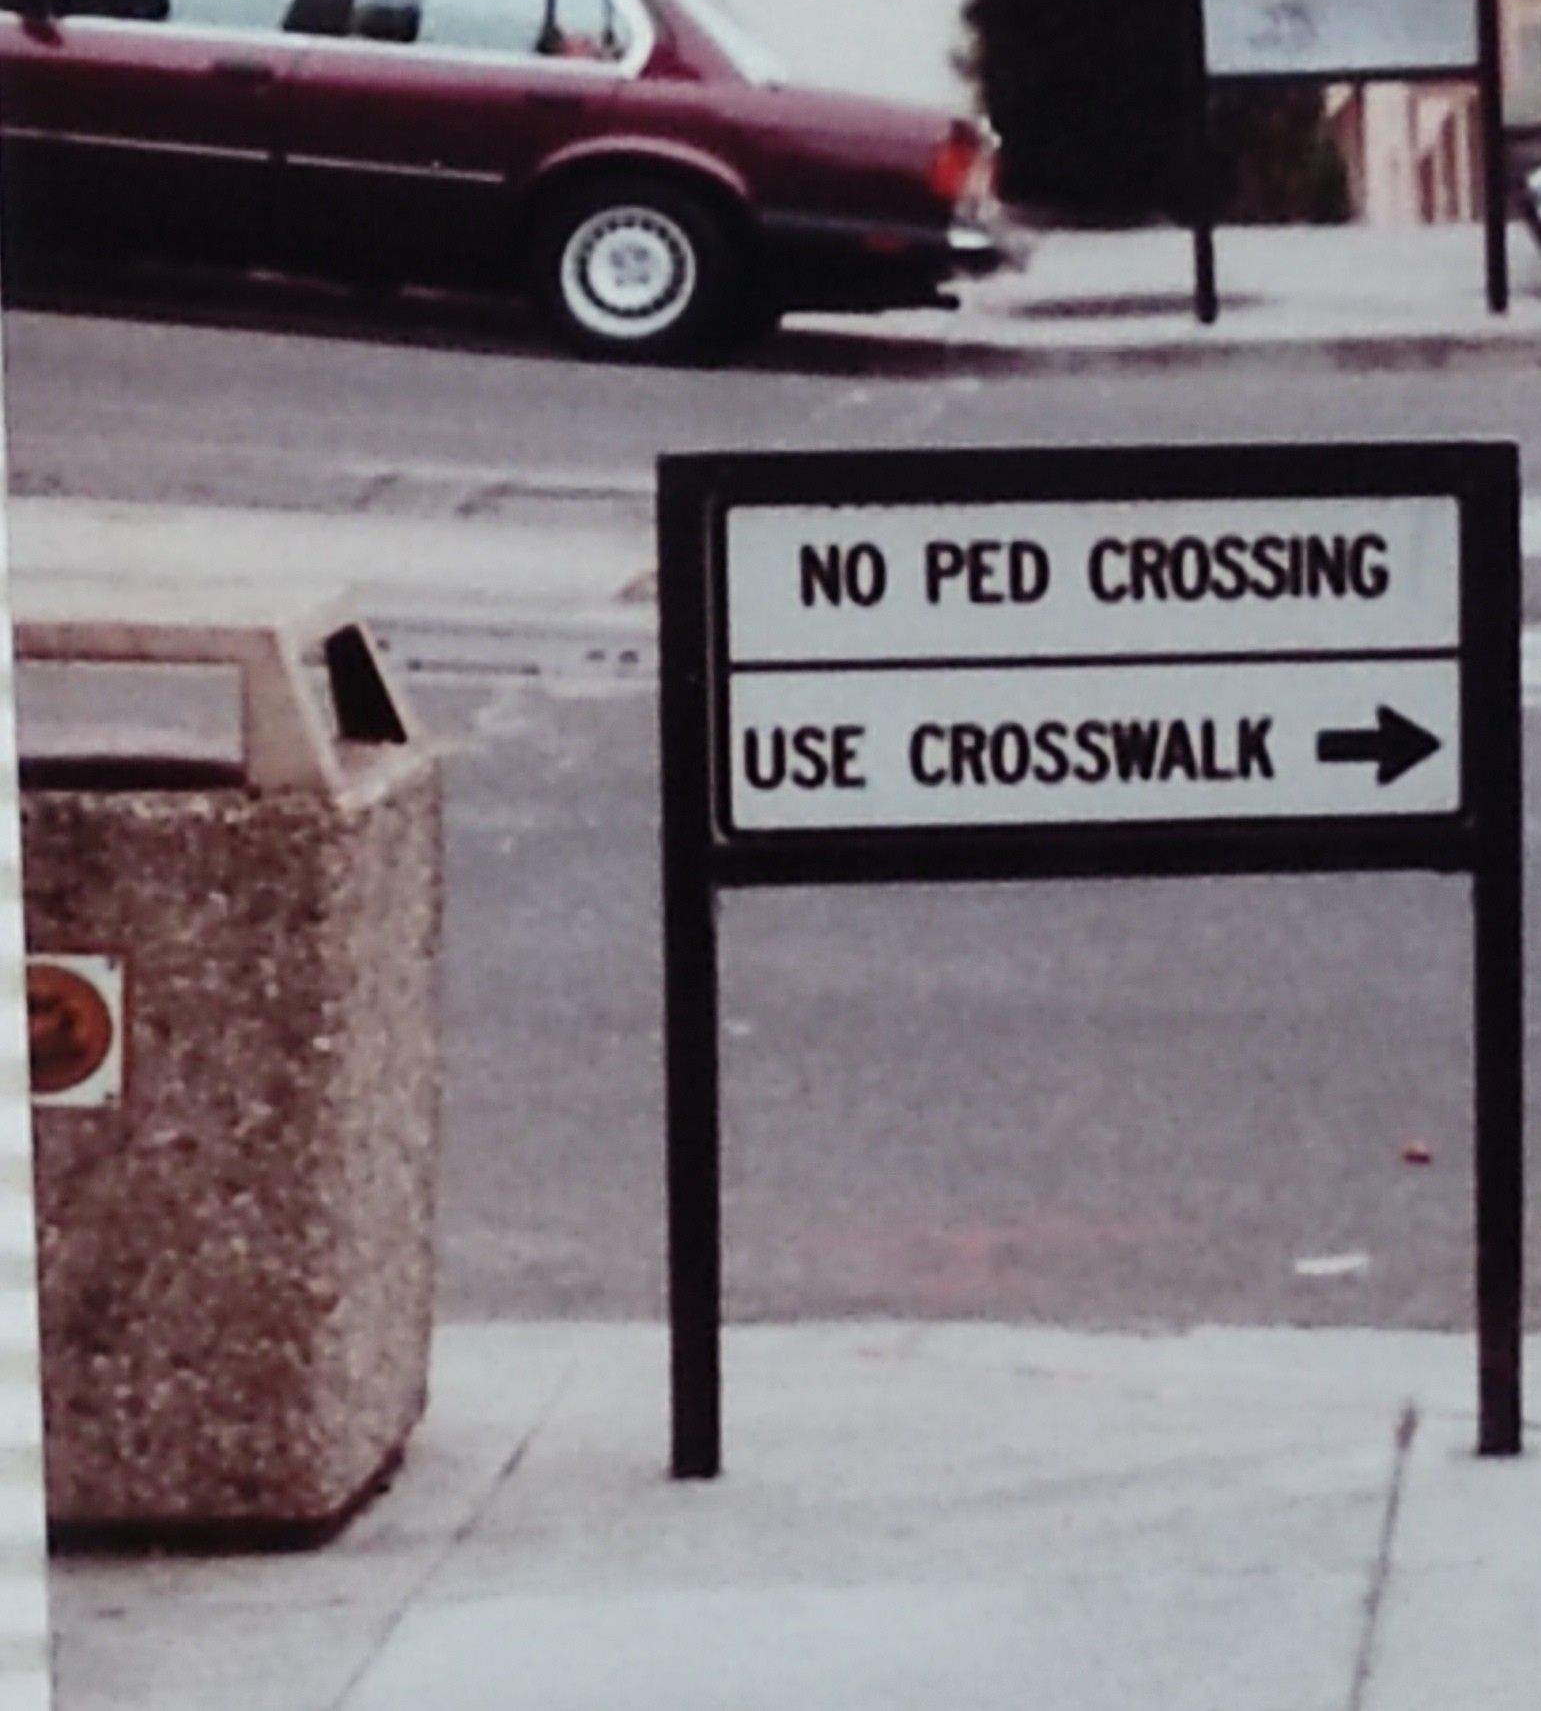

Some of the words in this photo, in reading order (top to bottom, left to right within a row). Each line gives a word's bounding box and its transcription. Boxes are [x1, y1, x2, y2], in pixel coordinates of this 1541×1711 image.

[799, 541, 888, 608] NO
[924, 539, 1051, 606] PED
[1087, 532, 1390, 604] CROSSING
[743, 724, 867, 791] USE
[908, 716, 1275, 788] CROSSWALK
